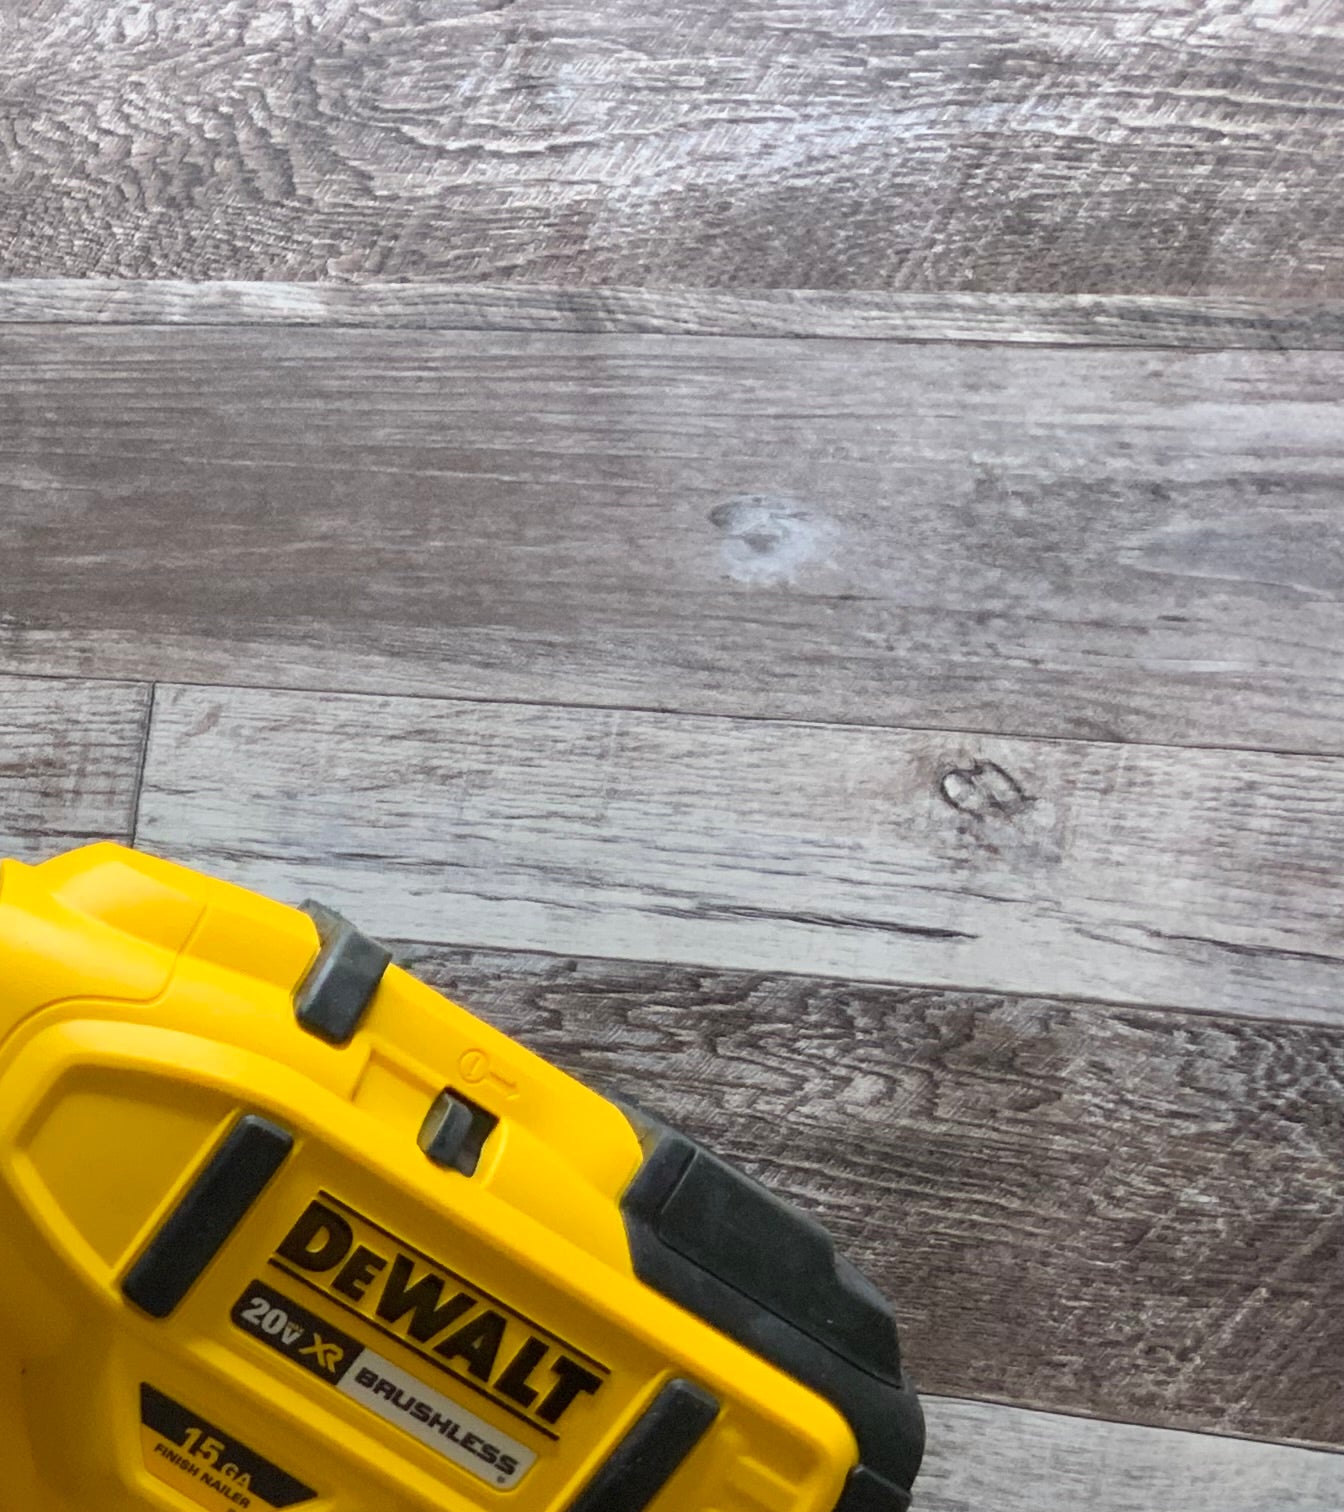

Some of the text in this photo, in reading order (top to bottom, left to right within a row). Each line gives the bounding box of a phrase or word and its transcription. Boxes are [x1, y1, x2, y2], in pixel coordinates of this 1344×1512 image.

[299, 1332, 344, 1373] XR
[354, 1367, 520, 1476] BRUSHLESS
[154, 1443, 250, 1509] FINISH NAILER
